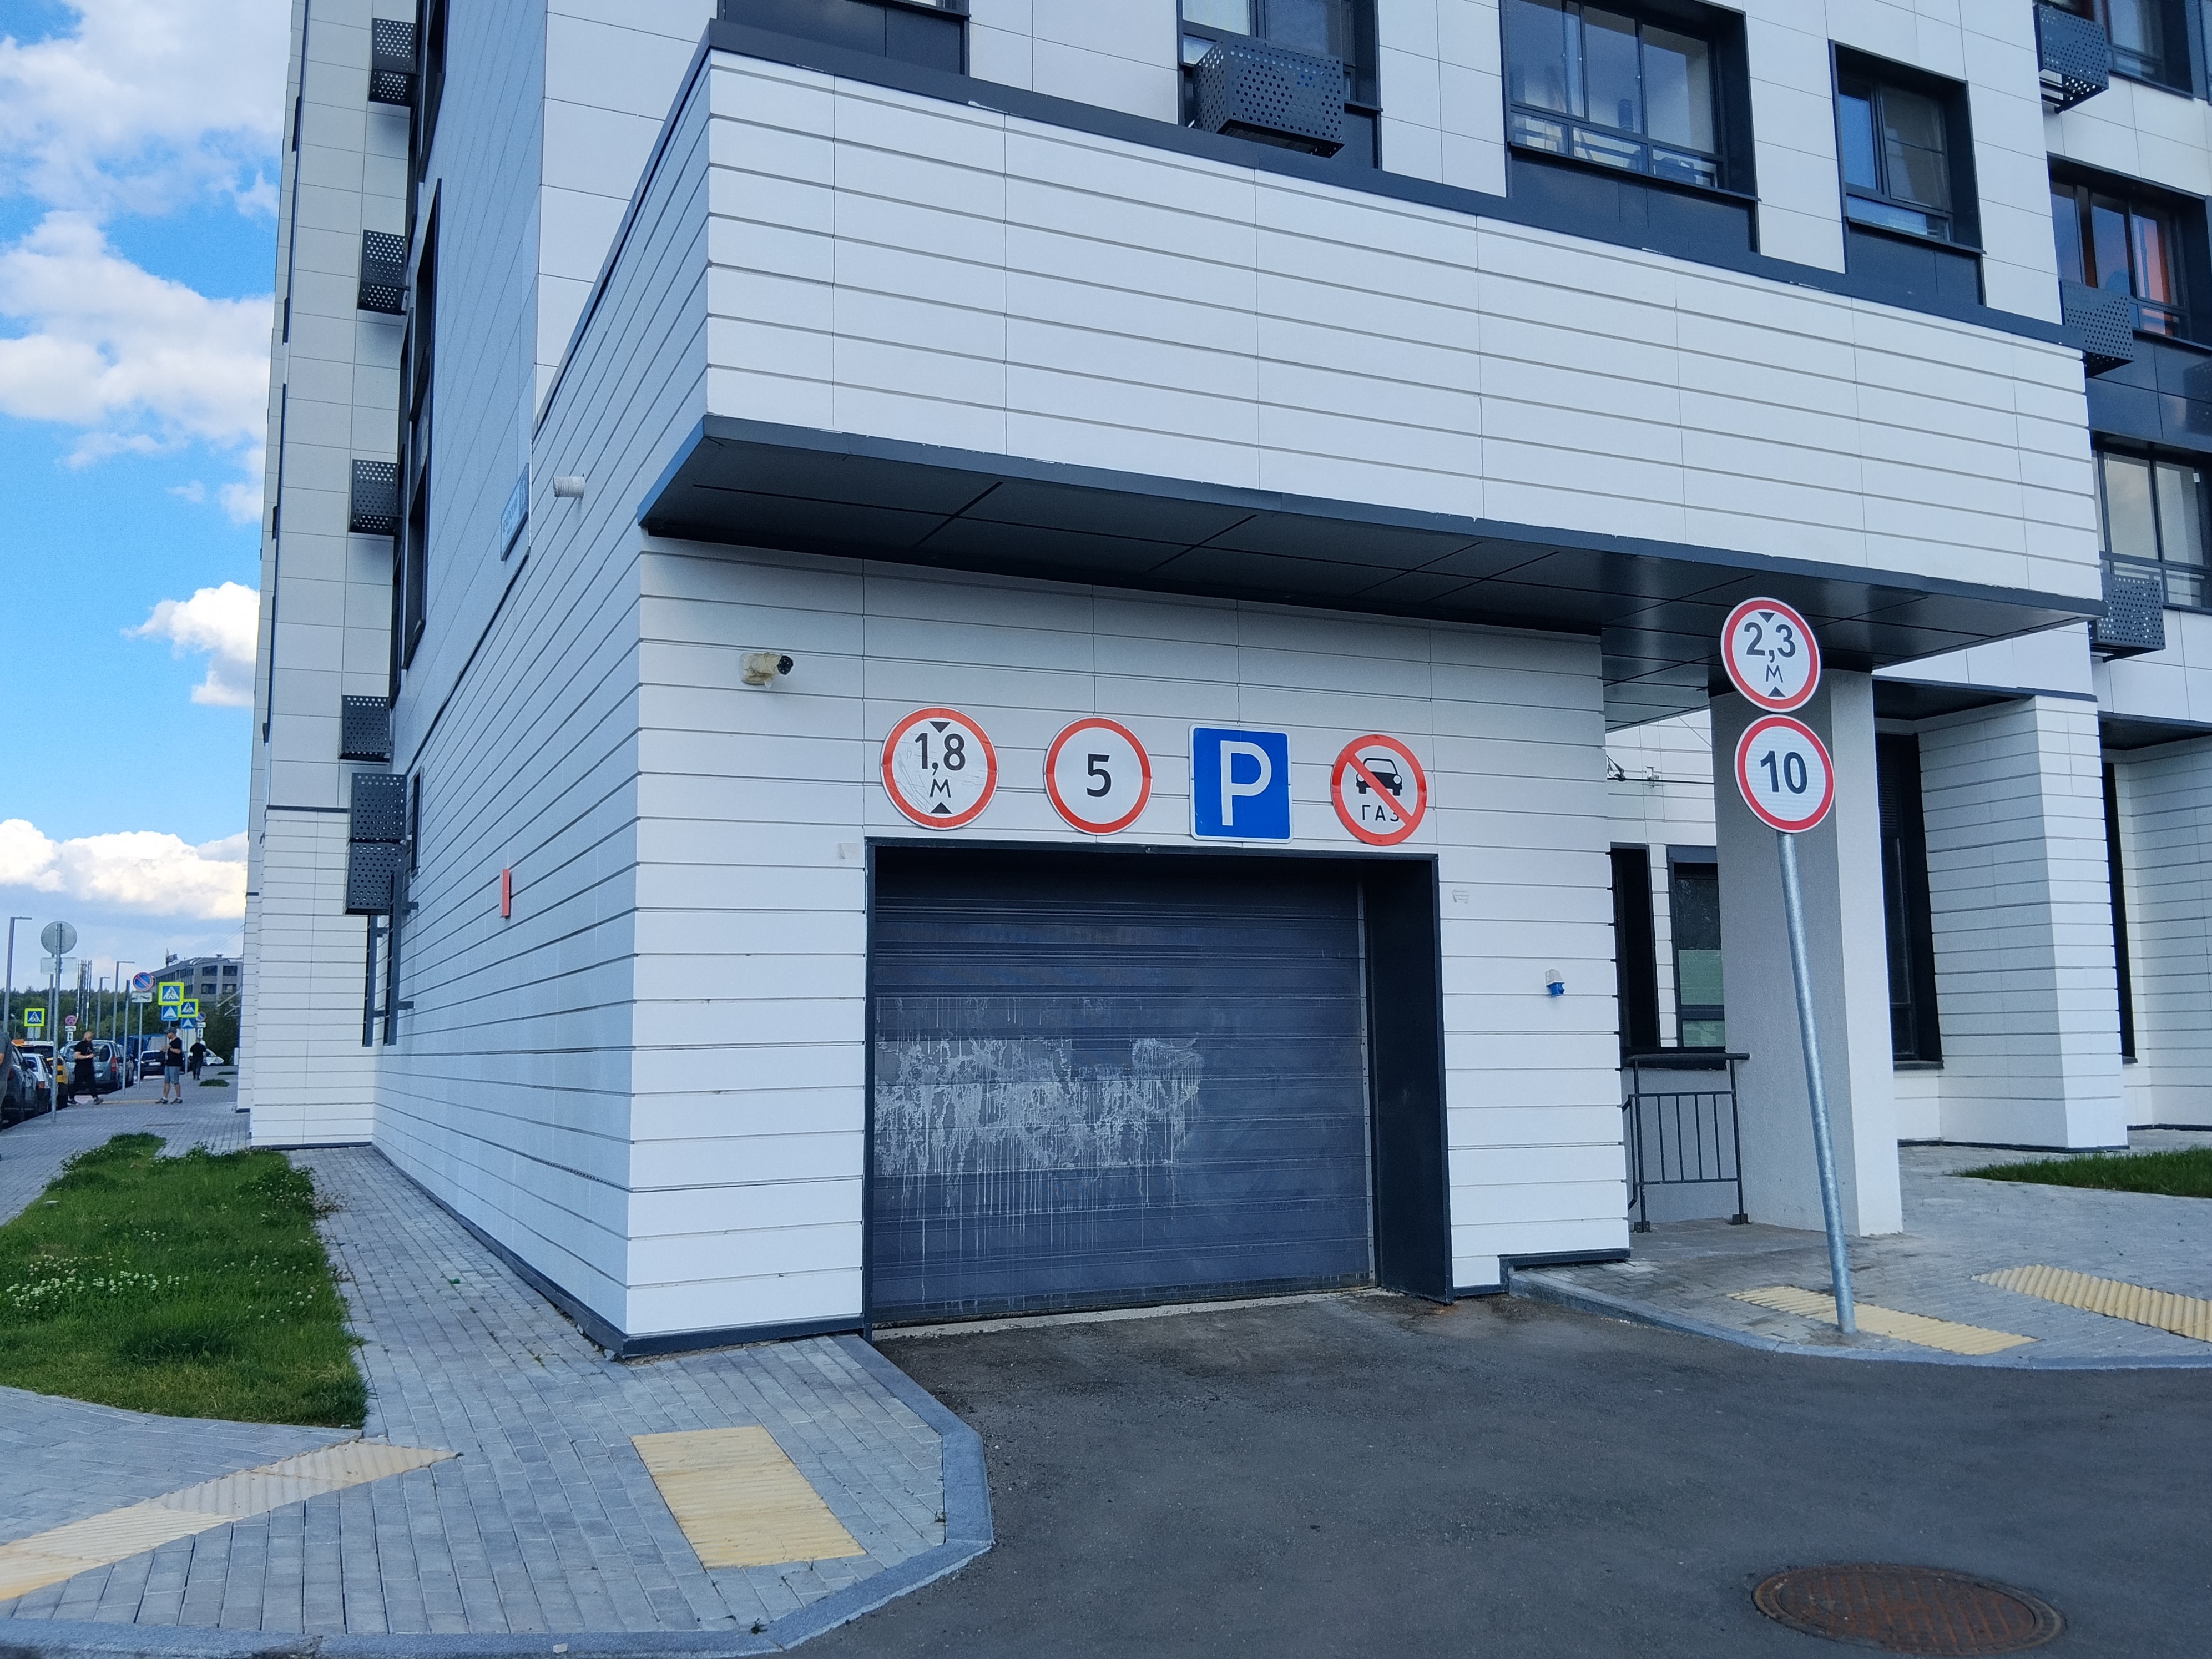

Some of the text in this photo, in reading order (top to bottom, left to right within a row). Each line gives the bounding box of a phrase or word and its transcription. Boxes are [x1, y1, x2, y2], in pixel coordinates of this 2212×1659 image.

[1744, 622, 1796, 663] 2,3
[915, 733, 966, 776] 1,8
[1086, 753, 1112, 798] 5
[1760, 750, 1807, 794] 10
[1220, 740, 1272, 826] P
